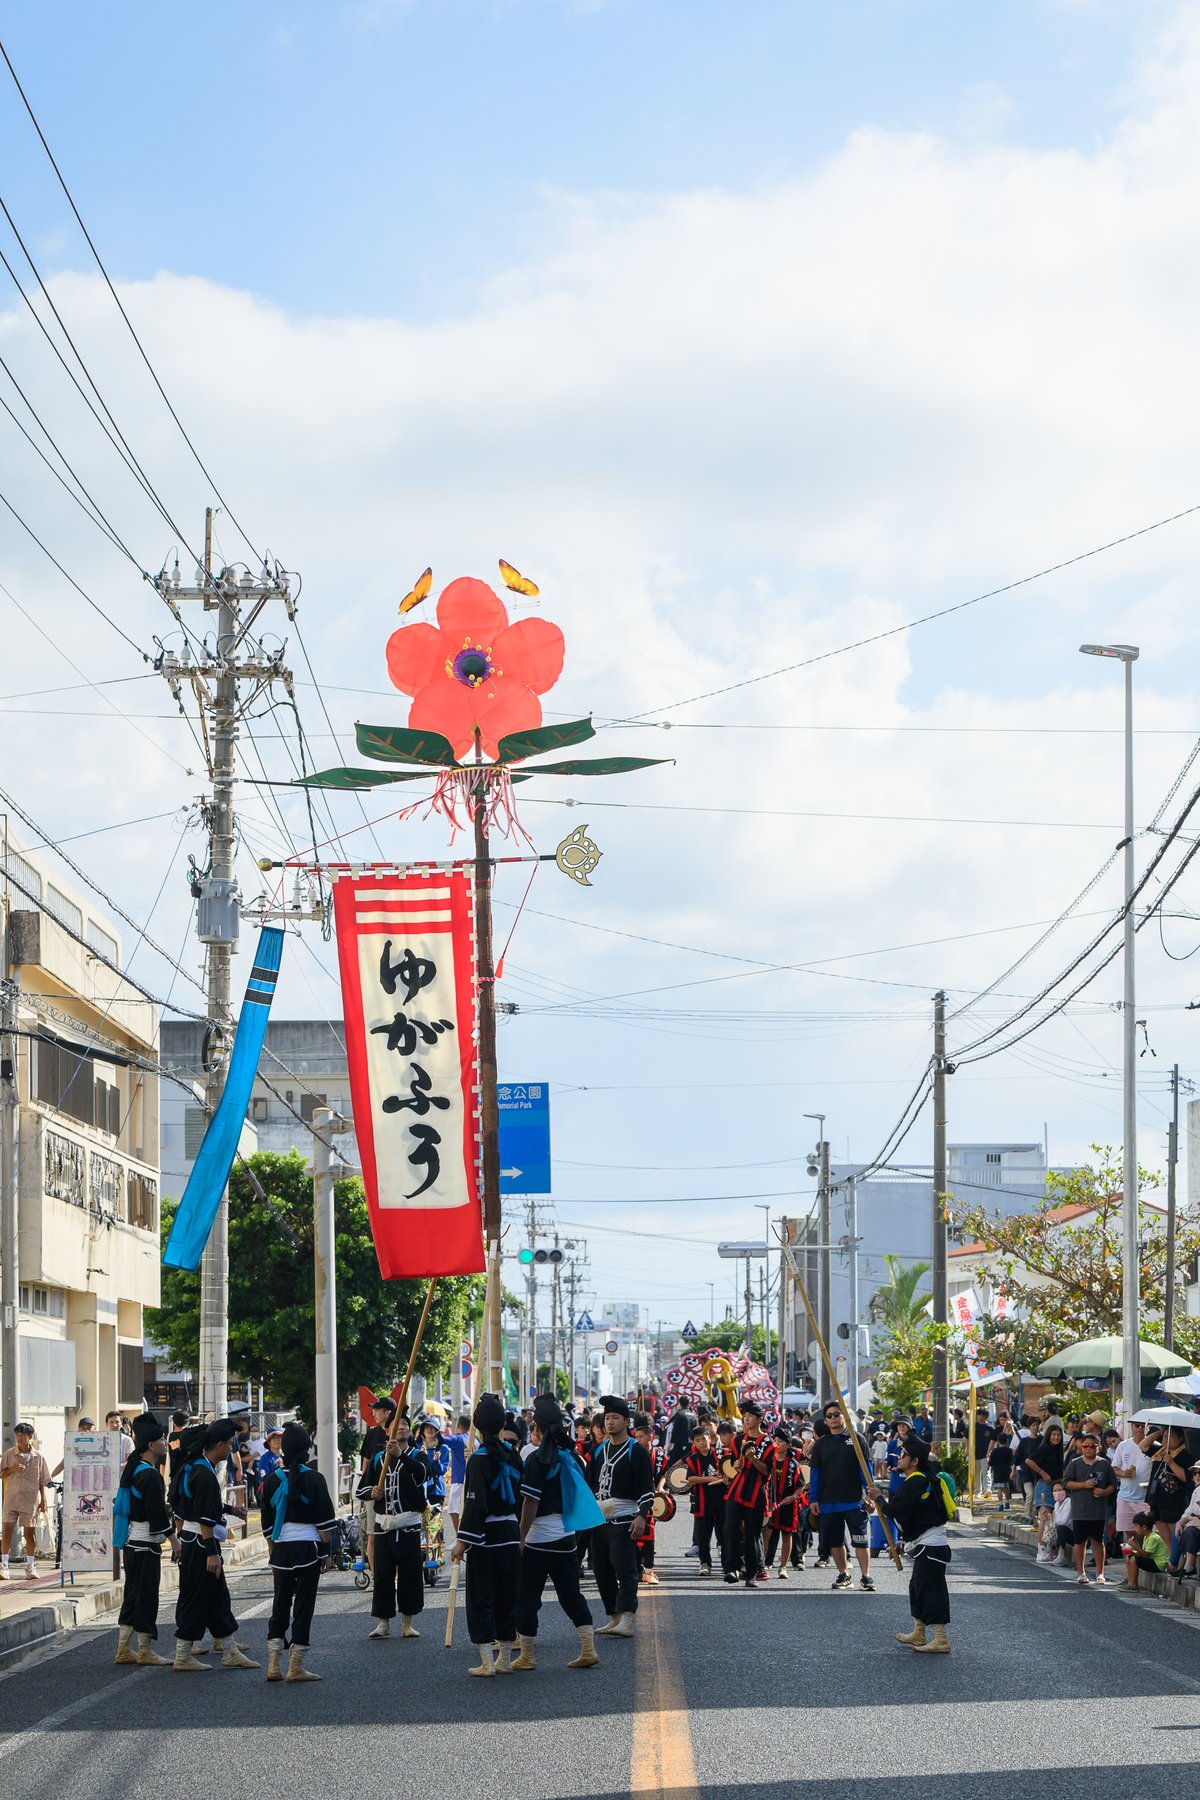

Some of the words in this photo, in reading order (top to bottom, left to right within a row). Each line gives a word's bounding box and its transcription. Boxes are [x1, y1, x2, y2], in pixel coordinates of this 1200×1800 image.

[370, 940, 455, 1200] ゆがふう
[520, 1101, 532, 1109] Park
